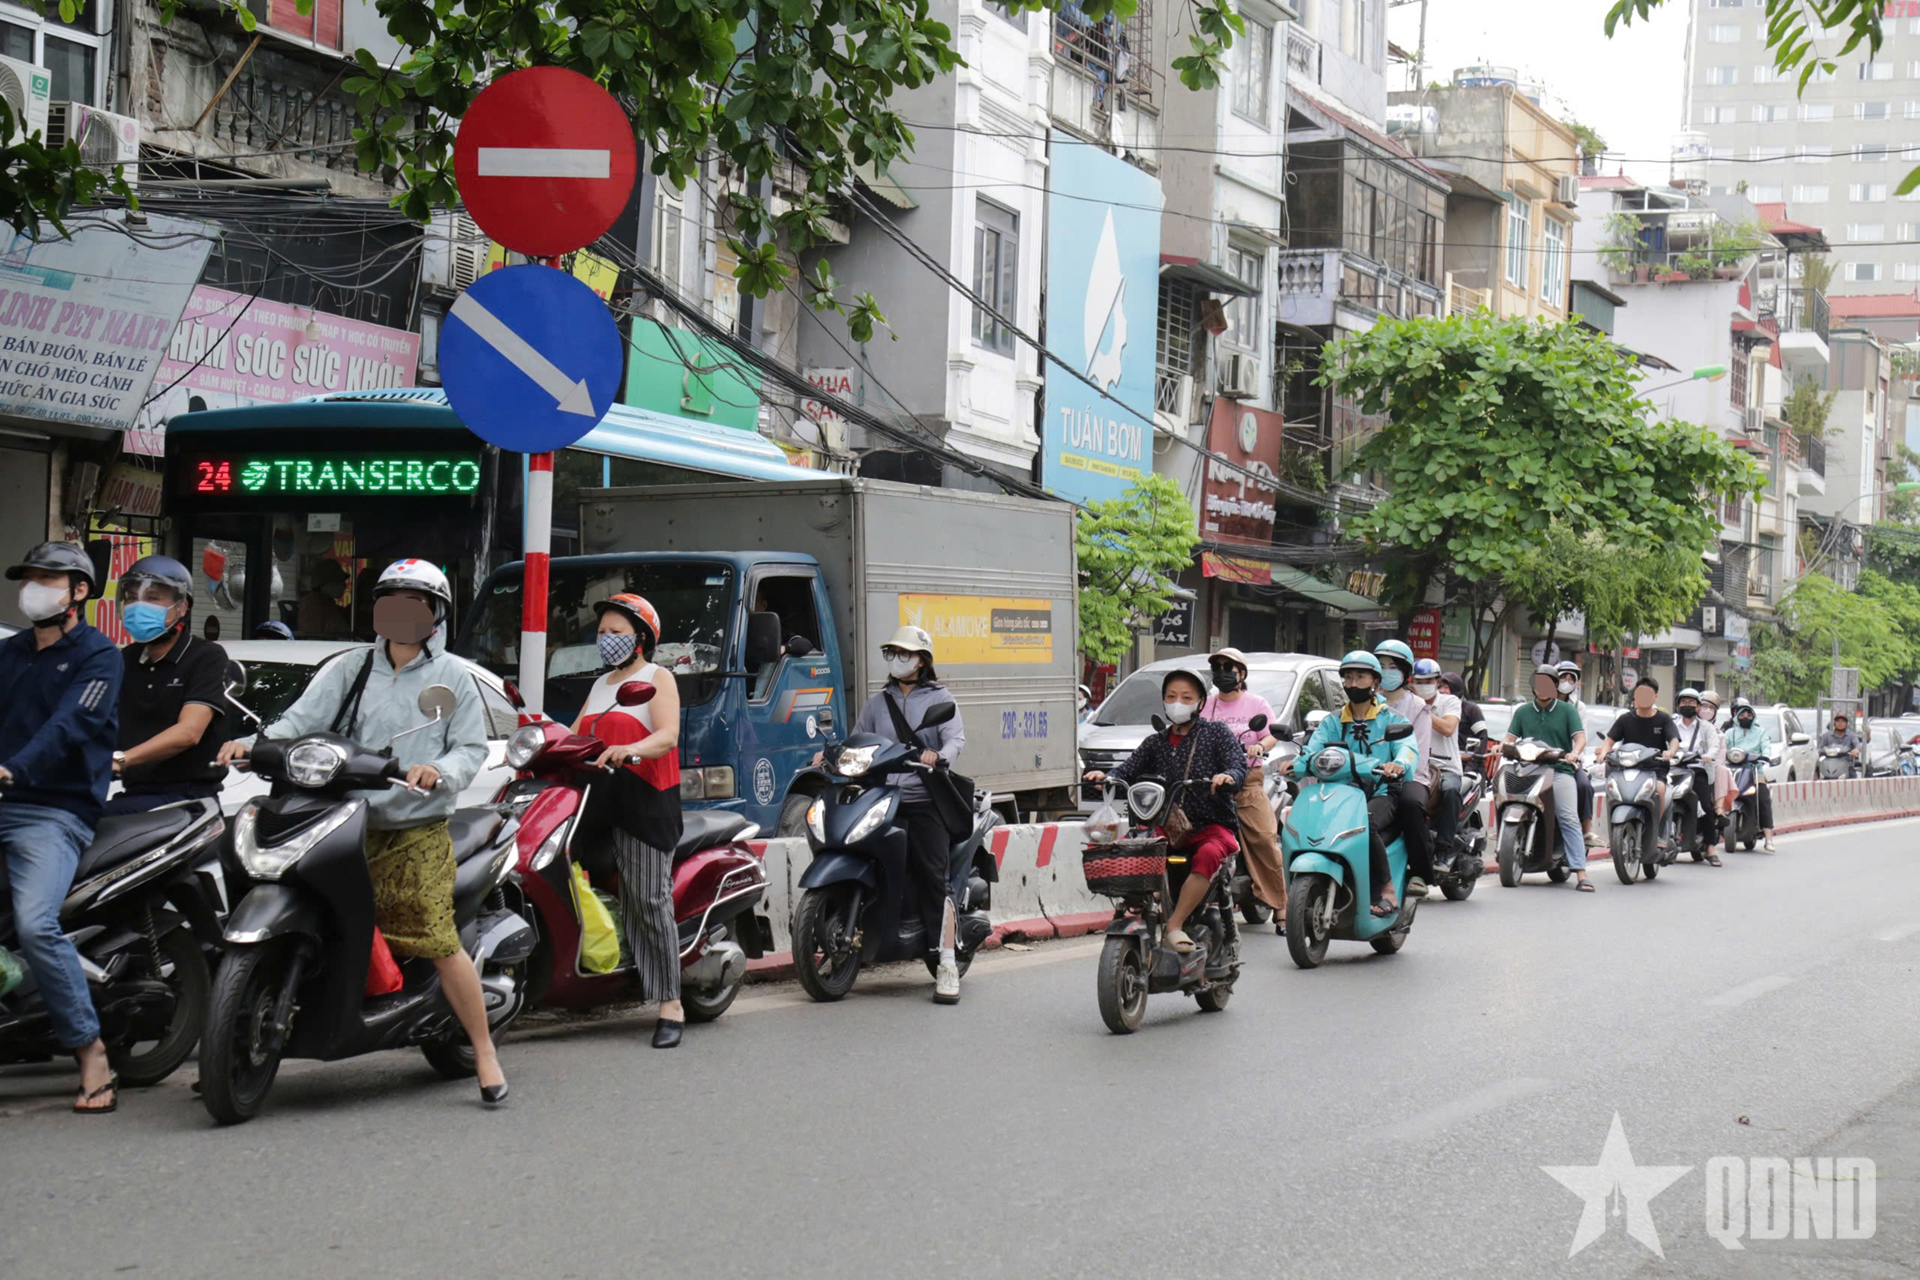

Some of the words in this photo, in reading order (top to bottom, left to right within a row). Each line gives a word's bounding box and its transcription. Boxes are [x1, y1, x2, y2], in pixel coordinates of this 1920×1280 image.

[123, 145, 134, 154] LG
[51, 301, 104, 340] PET
[98, 309, 171, 351] MART
[253, 308, 277, 326] THEO
[341, 327, 348, 341] Y
[348, 330, 366, 347] HỌC
[2, 335, 39, 354] BÁN
[40, 343, 88, 365] BUÔN,
[92, 350, 130, 369] BÁN
[127, 356, 148, 373] LẺ
[234, 331, 287, 381] SÓC
[291, 343, 342, 391] SỨC
[346, 352, 404, 392] KHỎE
[14, 361, 50, 378] CHÓ
[51, 366, 88, 385] MÈO
[90, 371, 134, 392] CẢNH
[32, 383, 58, 402] ĂN
[60, 390, 86, 407] GIA
[89, 393, 121, 411] SÚC
[806, 400, 840, 420] SA
[1060, 404, 1104, 454] TUẤN
[1107, 419, 1142, 462] BƠM
[198, 461, 231, 491] 24
[274, 460, 480, 490] TRANSERCO
[1171, 602, 1188, 611] AI
[924, 614, 990, 639] LALAMOVE
[1002, 710, 1017, 739] 29C
